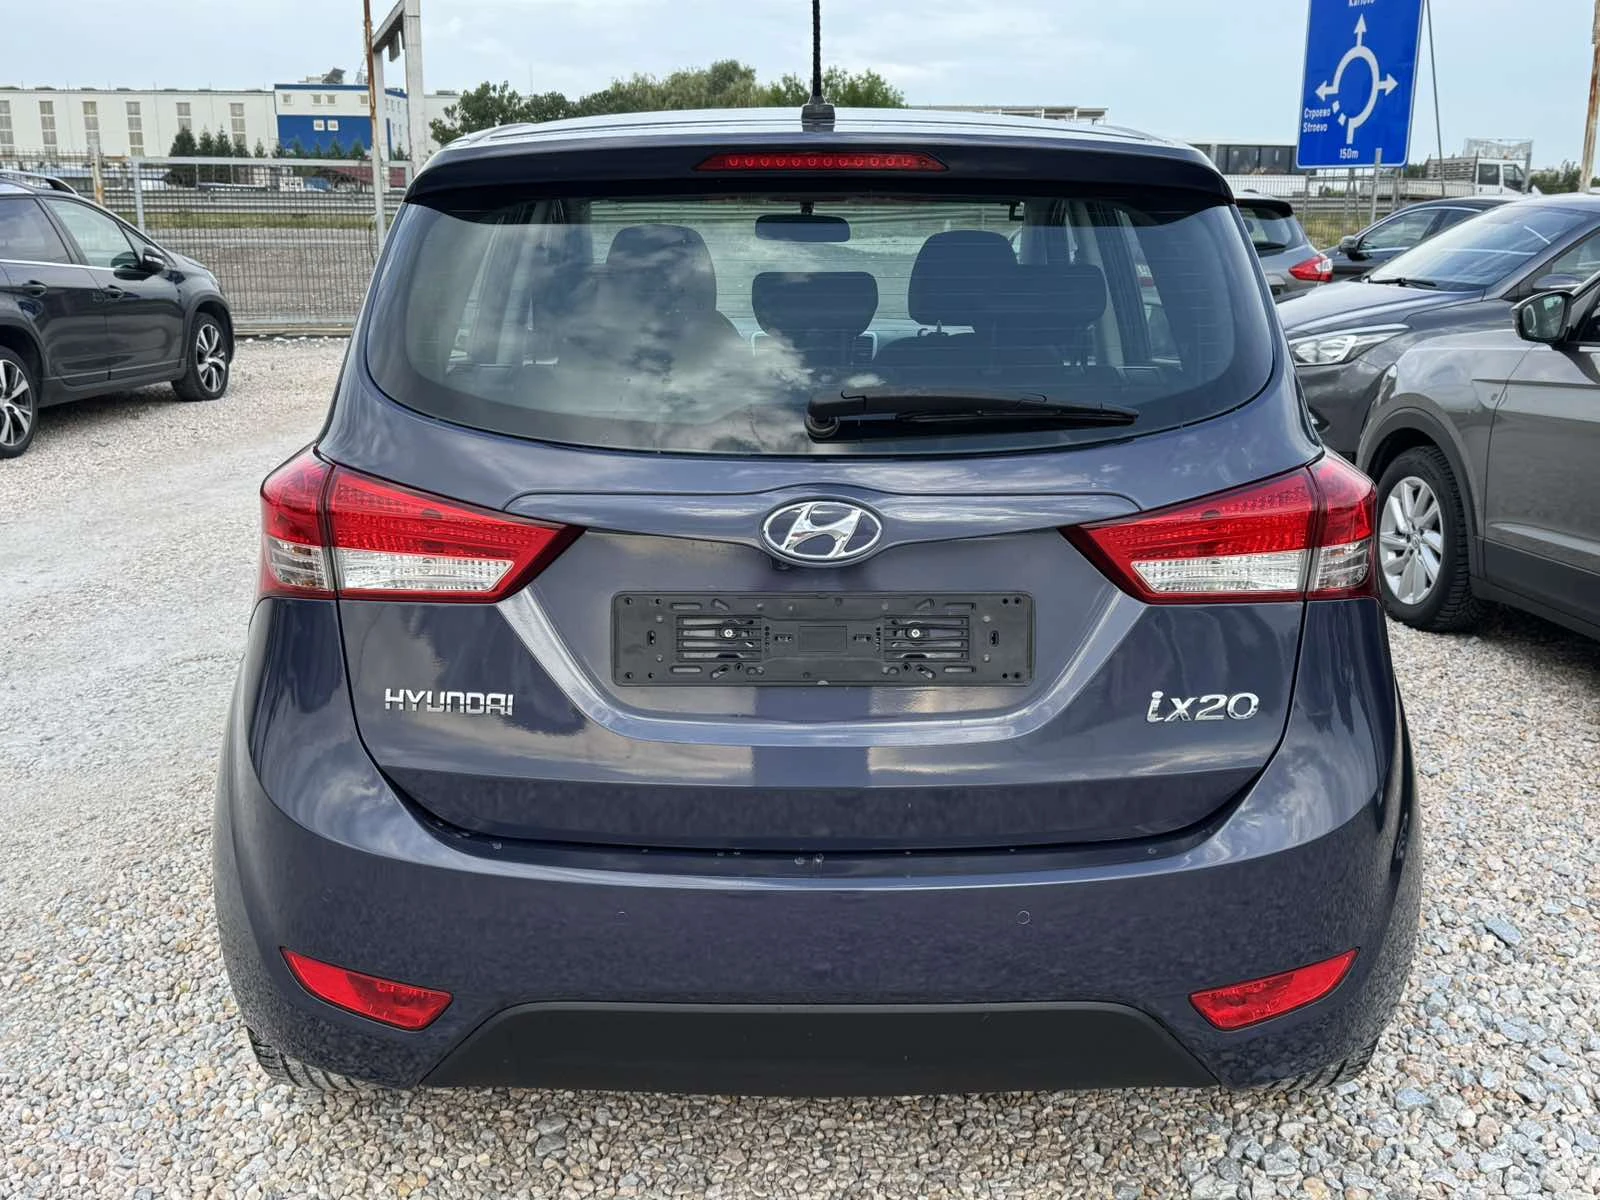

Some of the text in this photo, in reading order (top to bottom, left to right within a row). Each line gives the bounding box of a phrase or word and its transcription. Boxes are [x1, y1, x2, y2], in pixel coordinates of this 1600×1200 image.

[1304, 107, 1331, 120] Строево
[1303, 122, 1328, 133] Stroevo
[1339, 147, 1359, 160] 150m
[384, 687, 514, 716] HYUNDAI
[1146, 690, 1260, 723] ix20
